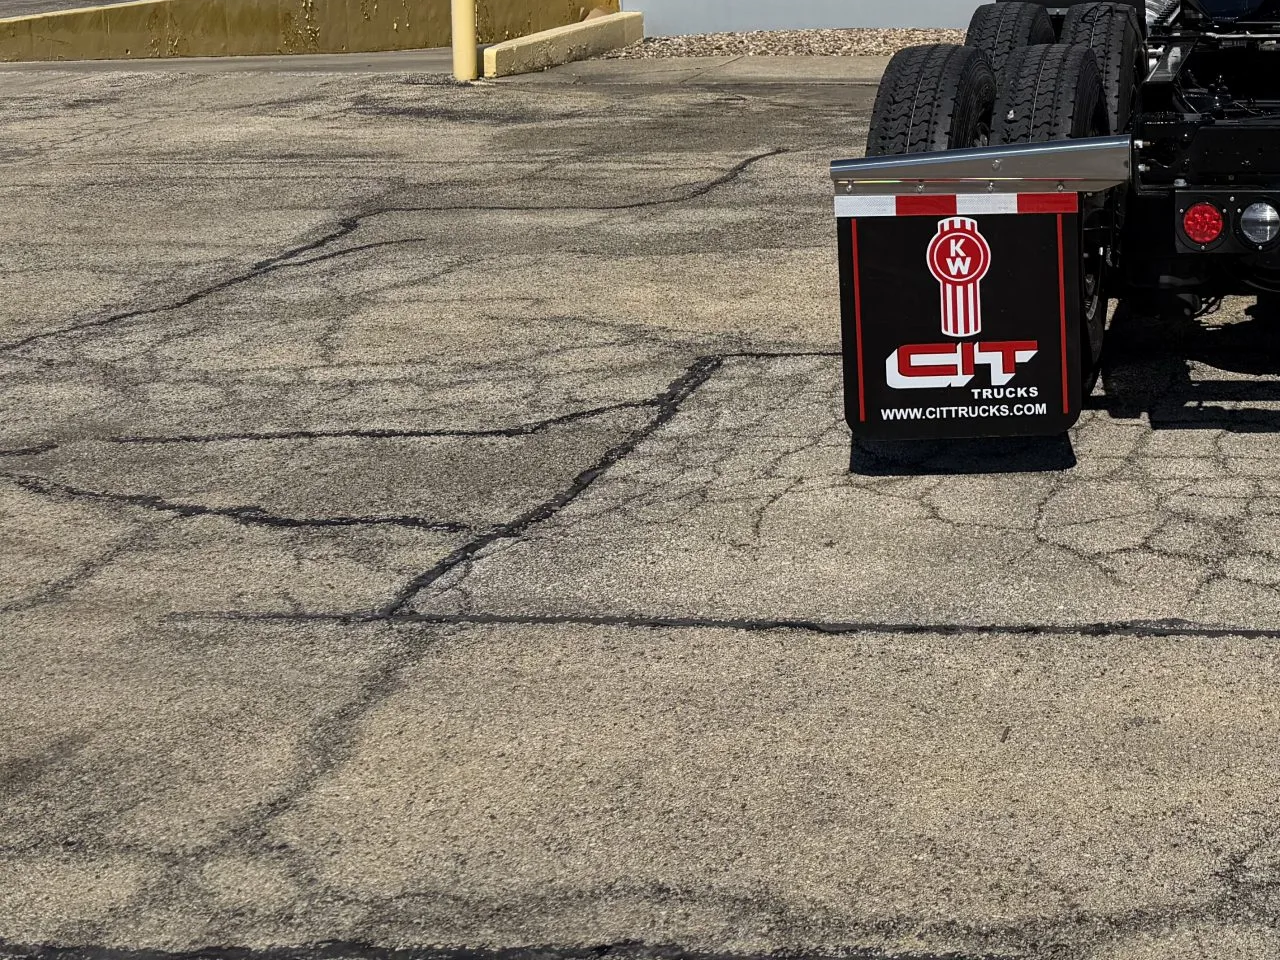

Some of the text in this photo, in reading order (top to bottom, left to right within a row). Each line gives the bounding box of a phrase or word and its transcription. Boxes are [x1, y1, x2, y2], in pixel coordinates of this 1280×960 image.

[950, 238, 966, 257] K
[946, 257, 971, 275] W
[886, 340, 1038, 389] CIT
[971, 387, 1039, 399] TRUCKS
[881, 403, 1047, 420] WWW.CITTRUCKS.COM
